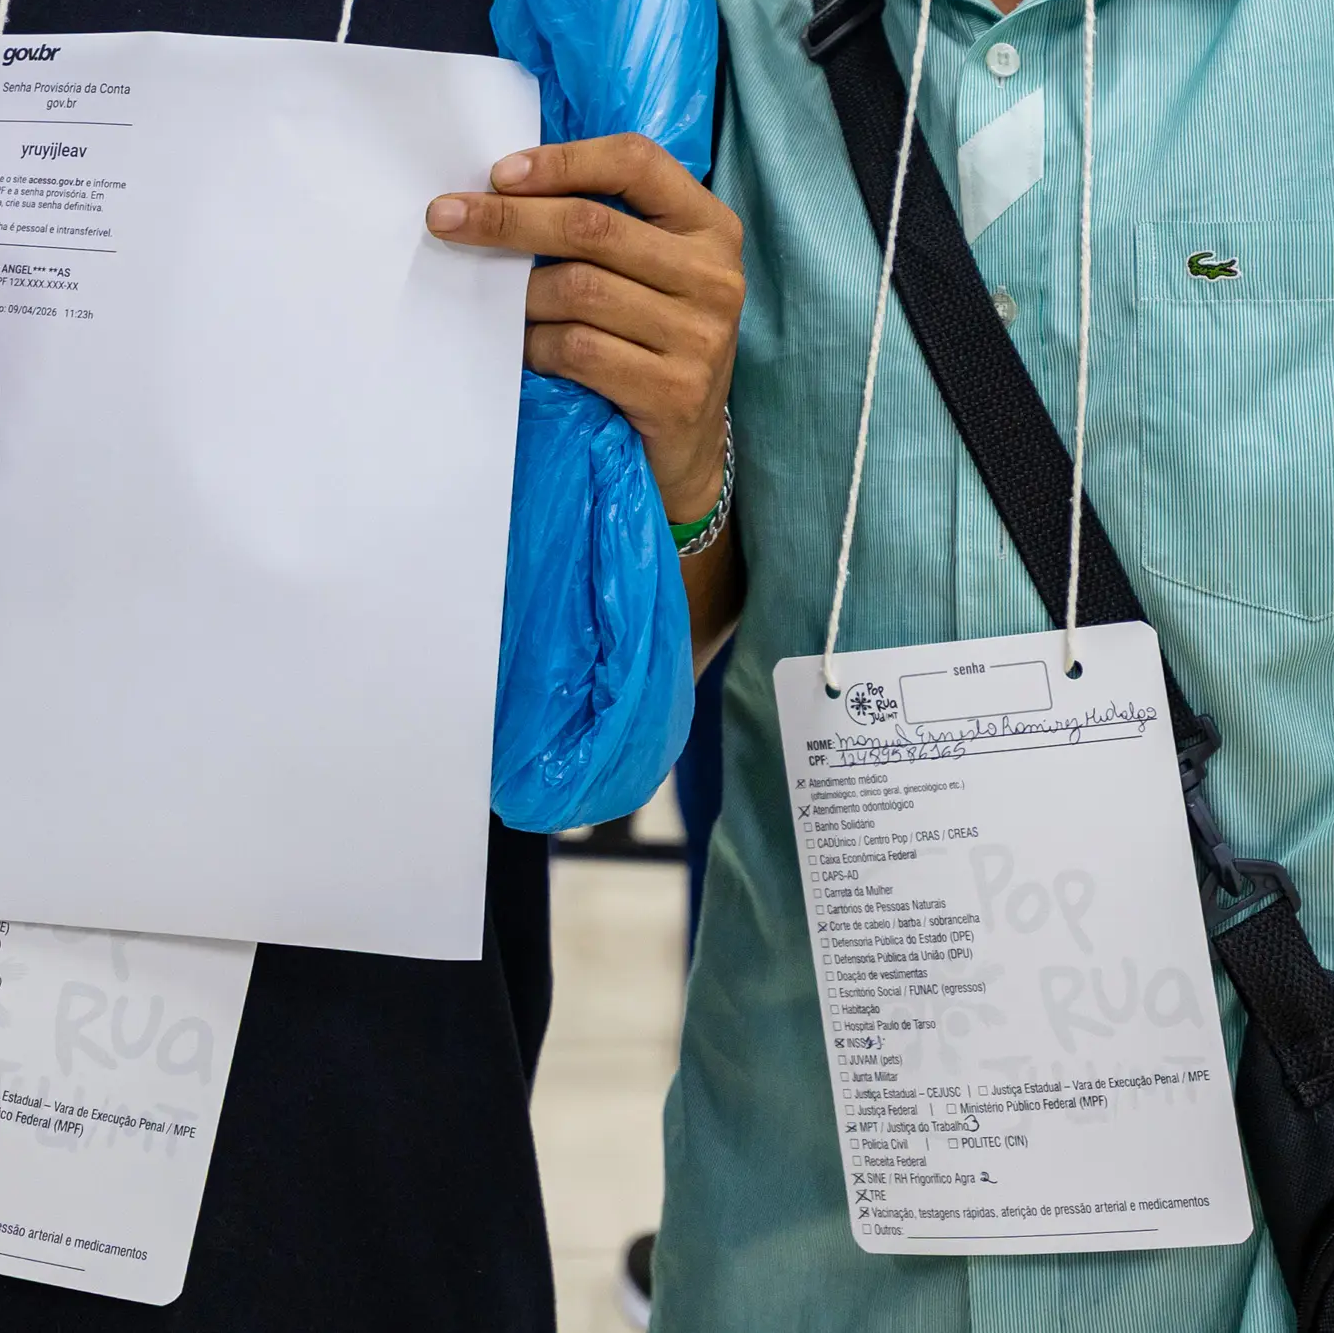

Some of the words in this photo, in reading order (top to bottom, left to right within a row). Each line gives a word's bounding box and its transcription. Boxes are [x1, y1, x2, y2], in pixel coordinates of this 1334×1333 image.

[2, 44, 61, 66] gov.br
[2, 81, 32, 93] Senha
[33, 81, 82, 93] Provisória
[83, 82, 97, 94] da
[99, 82, 131, 95] Conta
[45, 97, 78, 111] gov.br
[12, 175, 27, 184] site
[27, 176, 85, 188] acesso.gov.br
[85, 179, 92, 187] e
[92, 178, 127, 189] informe
[20, 187, 45, 197] senha
[45, 188, 88, 199] provisória.
[90, 190, 105, 200] Em
[5, 198, 20, 208] crie
[21, 200, 36, 208] sua
[37, 199, 62, 210] senha
[63, 201, 103, 212] definitiva.
[9, 222, 15, 231] é
[15, 223, 49, 233] pessoal
[48, 226, 55, 234] e
[56, 224, 113, 237] intransferível.
[8, 304, 57, 317] 09/04/2026
[64, 308, 94, 319] 11:23h
[952, 661, 986, 676] senha
[806, 740, 836, 751] NOME:
[809, 755, 829, 766] CPF:
[808, 776, 856, 788] Atendimento
[857, 773, 888, 784] médico
[812, 803, 861, 815] Atendimento
[861, 799, 914, 812] odontológico
[814, 820, 840, 832] Banho
[840, 818, 875, 830] Solidário
[816, 834, 857, 849] CADÚnico
[863, 834, 891, 846] Centro
[891, 832, 908, 845] Pop
[915, 829, 940, 842] CRAS
[947, 826, 979, 840] CREAS
[819, 854, 842, 865] Caixa
[841, 851, 887, 864] Econômica
[887, 848, 917, 861] Federal
[821, 869, 859, 882] CAPS-AD
[824, 887, 853, 898] Carreta
[853, 885, 865, 897] da
[865, 885, 893, 896] Mulher
[826, 903, 863, 915] Cartórios
[863, 902, 875, 913] de
[875, 901, 911, 912] Pessoas
[911, 898, 947, 910] Naturais
[828, 920, 851, 932] Corte
[852, 919, 863, 931] de
[863, 918, 891, 930] cabelo
[897, 916, 922, 929] barba
[928, 913, 981, 927] sobrancelha
[1, 1089, 43, 1109] Estadual
[54, 1100, 75, 1116] Vara
[76, 1106, 89, 1119] de
[90, 1108, 137, 1128] Execução
[138, 1117, 166, 1133] Penal
[172, 1123, 197, 1139] MPE
[14, 1110, 52, 1129] Federal
[53, 1118, 84, 1138] (MPF)
[27, 1228, 64, 1245] arterial
[64, 1236, 72, 1247] e
[73, 1238, 148, 1261] medicamentos
